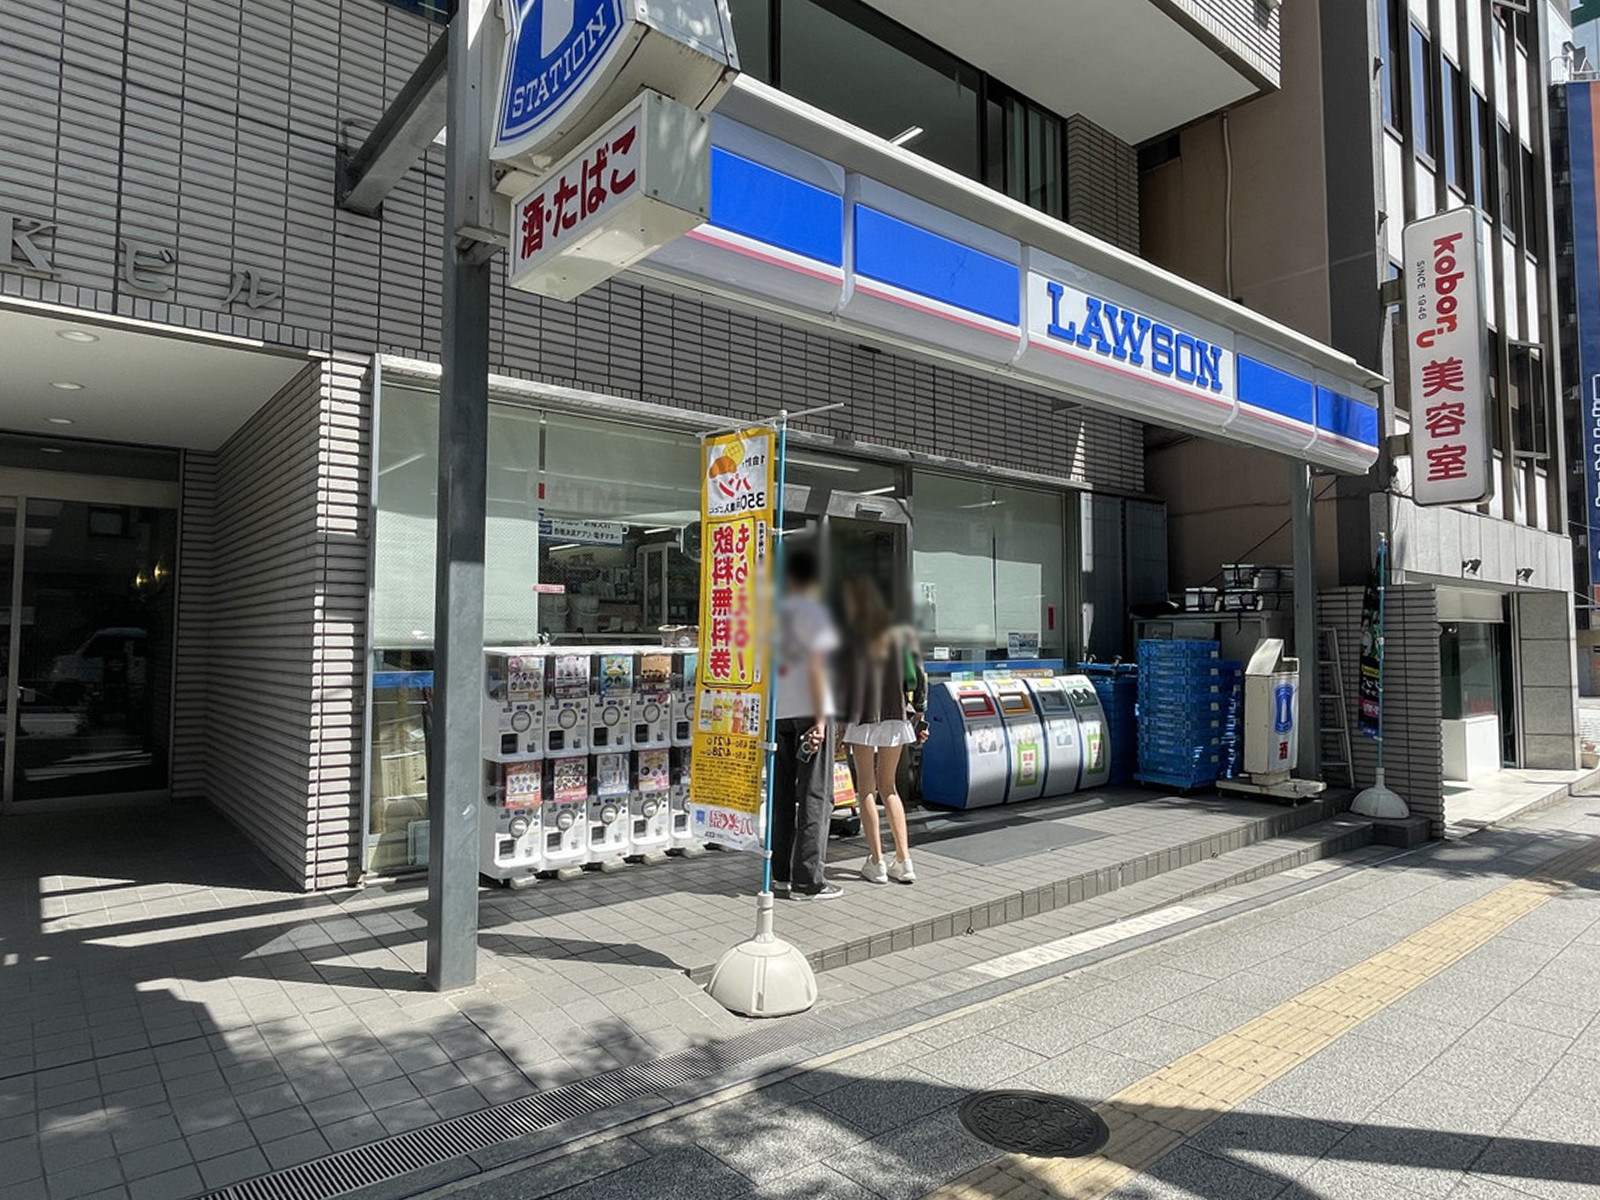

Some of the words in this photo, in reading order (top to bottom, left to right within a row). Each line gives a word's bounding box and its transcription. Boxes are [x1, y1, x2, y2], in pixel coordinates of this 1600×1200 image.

[511, 3, 608, 119] STATION
[521, 125, 636, 260] 酒・たばこ
[1416, 260, 1426, 290] SINCE
[1047, 281, 1223, 392] LAWSON
[1422, 357, 1468, 482] 美容室
